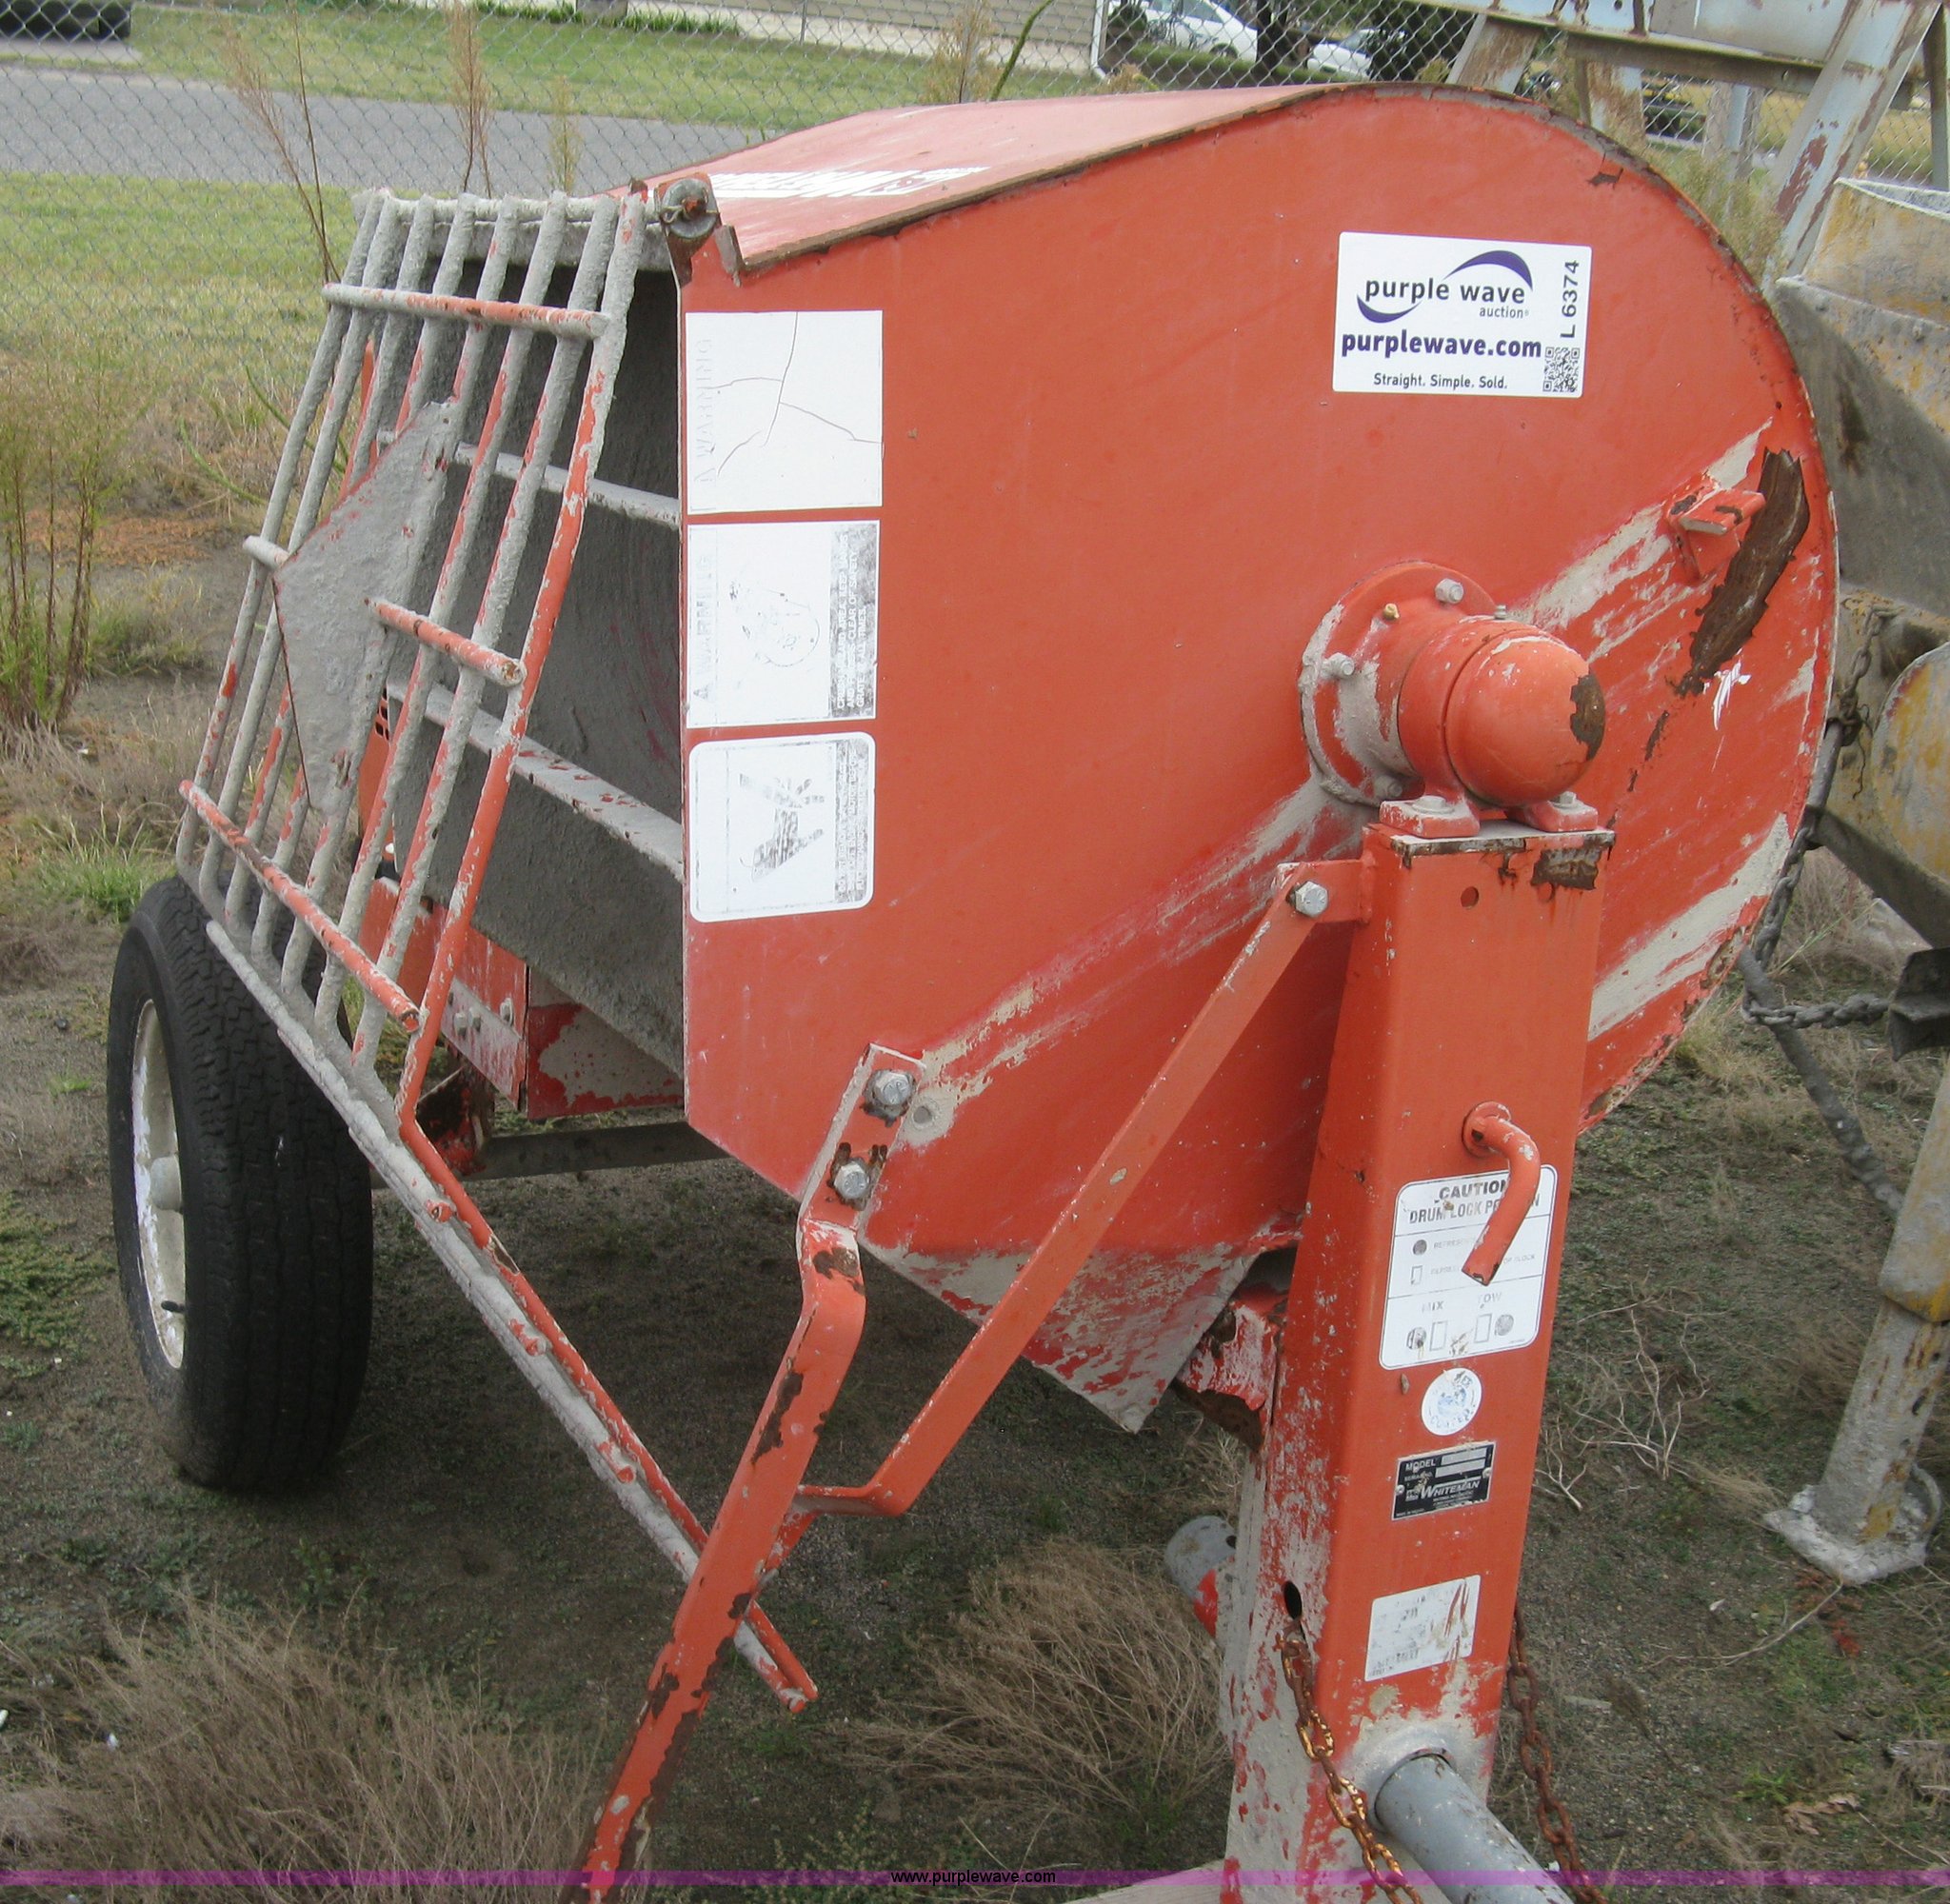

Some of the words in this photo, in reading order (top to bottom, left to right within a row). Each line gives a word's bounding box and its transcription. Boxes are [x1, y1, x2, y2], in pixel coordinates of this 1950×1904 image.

[1364, 277, 1450, 304] purple
[1460, 285, 1525, 305] wave
[1562, 260, 1580, 317] 6374
[1479, 306, 1523, 319] auction
[1560, 325, 1576, 339] L
[1341, 329, 1542, 359] purplewave.com
[1373, 372, 1426, 388] Straight.
[1430, 374, 1475, 390] Simple.
[1479, 375, 1508, 389] Sold.
[1405, 1458, 1436, 1472] MODEL
[1421, 1477, 1482, 1499] WHITEMAN
